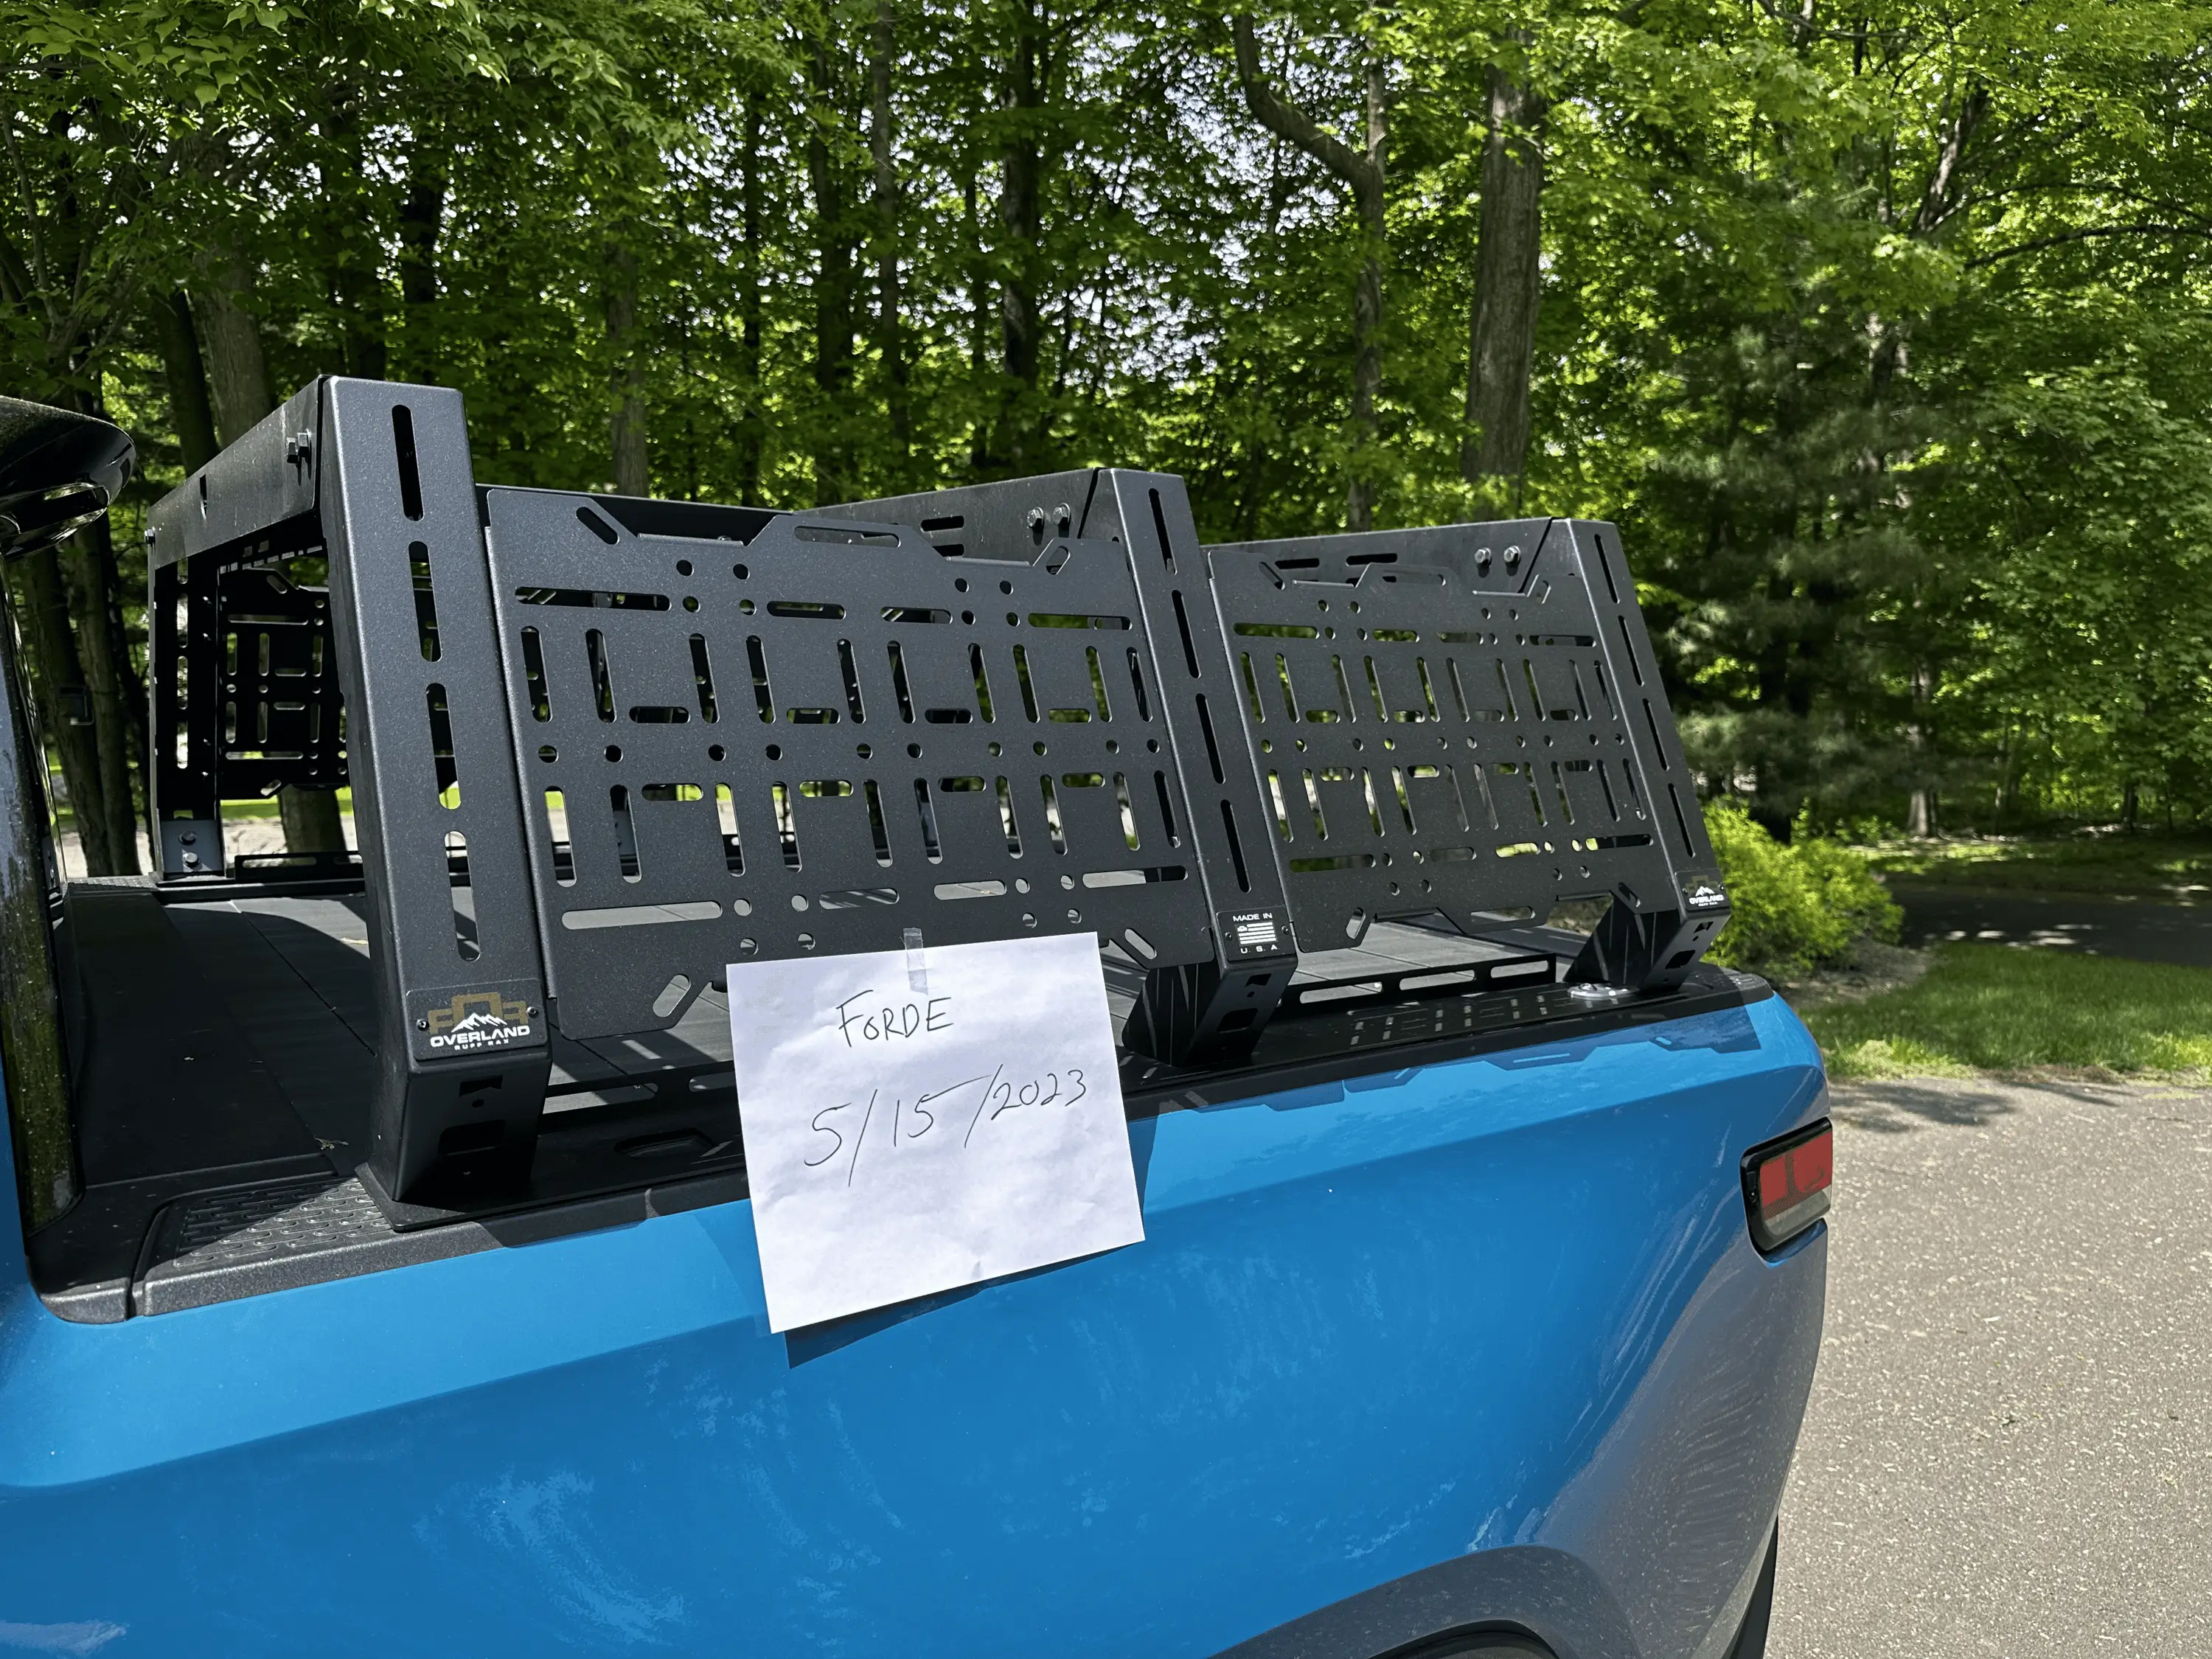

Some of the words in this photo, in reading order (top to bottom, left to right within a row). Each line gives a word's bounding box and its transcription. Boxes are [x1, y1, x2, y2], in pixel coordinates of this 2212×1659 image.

[1232, 914, 1259, 922] MADE
[430, 1025, 530, 1048] OVERLAND
[835, 990, 954, 1048] FORDE
[804, 1063, 1086, 1187] 5/15/2023
